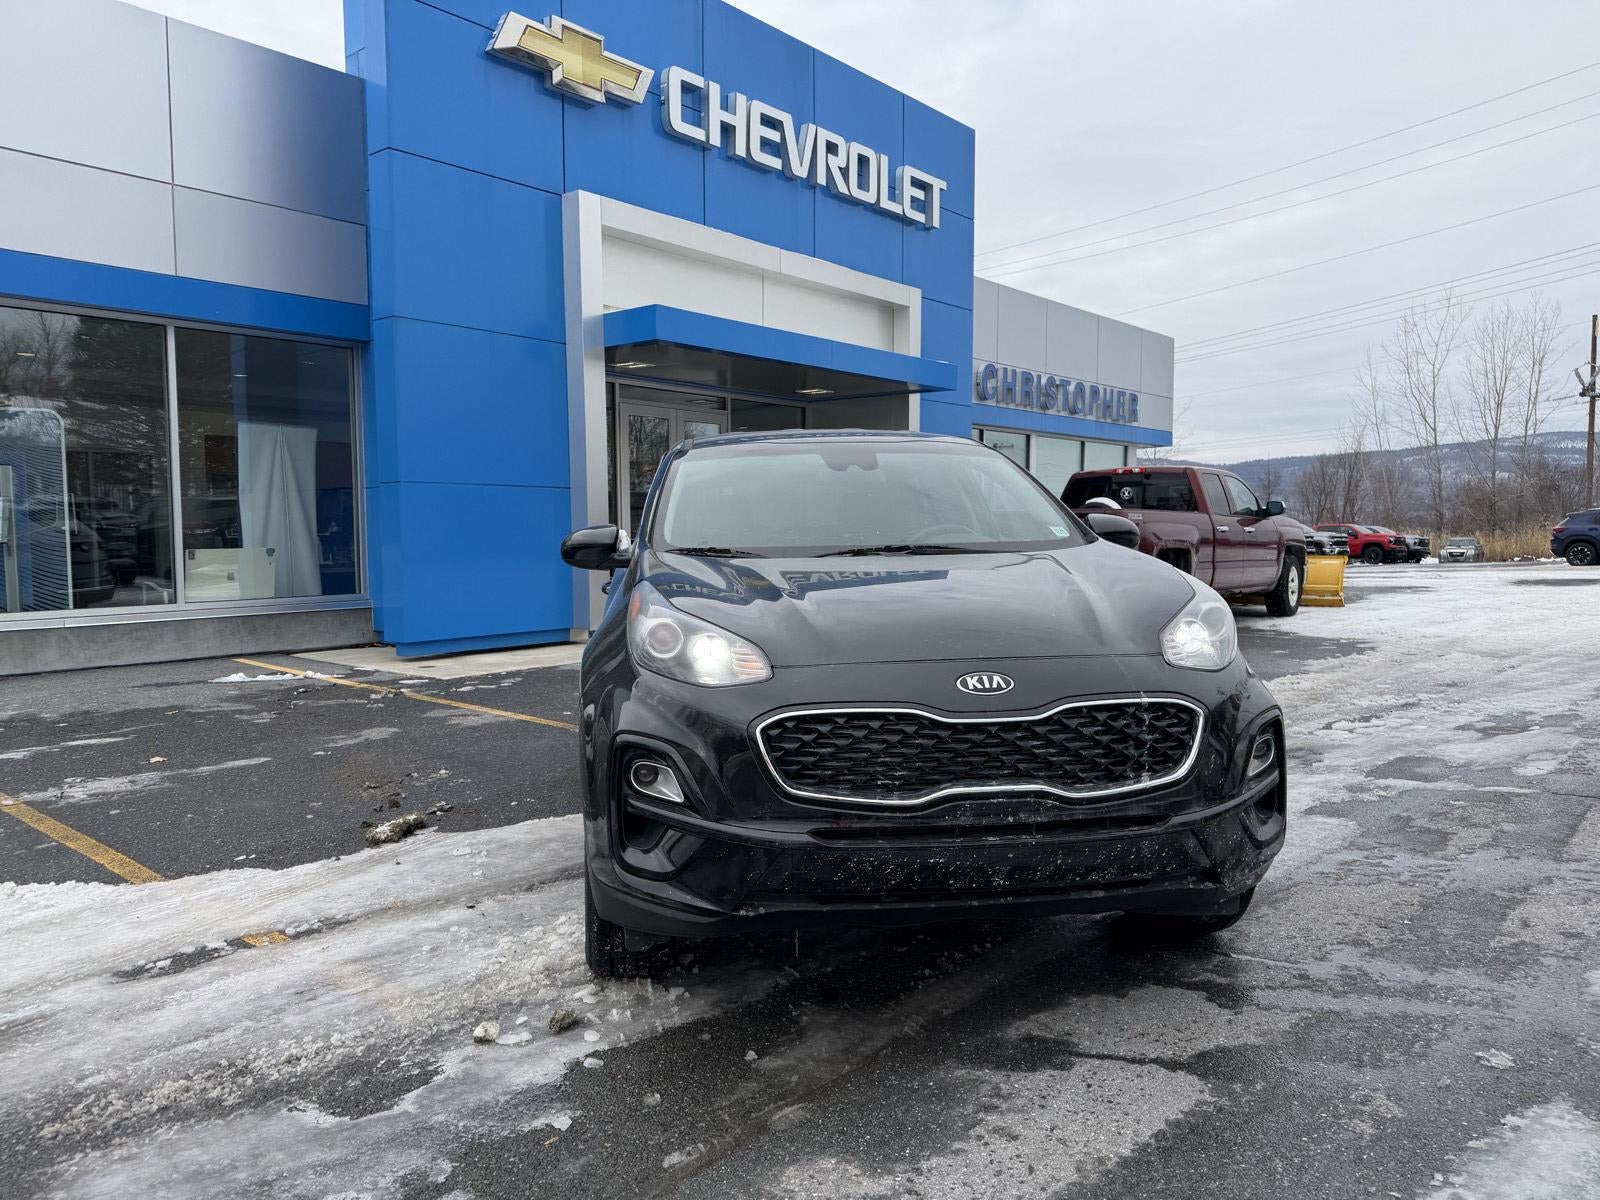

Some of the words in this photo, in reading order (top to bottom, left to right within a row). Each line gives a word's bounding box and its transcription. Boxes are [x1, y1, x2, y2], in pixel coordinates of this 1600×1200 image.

[661, 65, 947, 229] CHEVROLET
[977, 363, 1139, 423] CHRISTOPHER
[965, 675, 1007, 690] KIA
